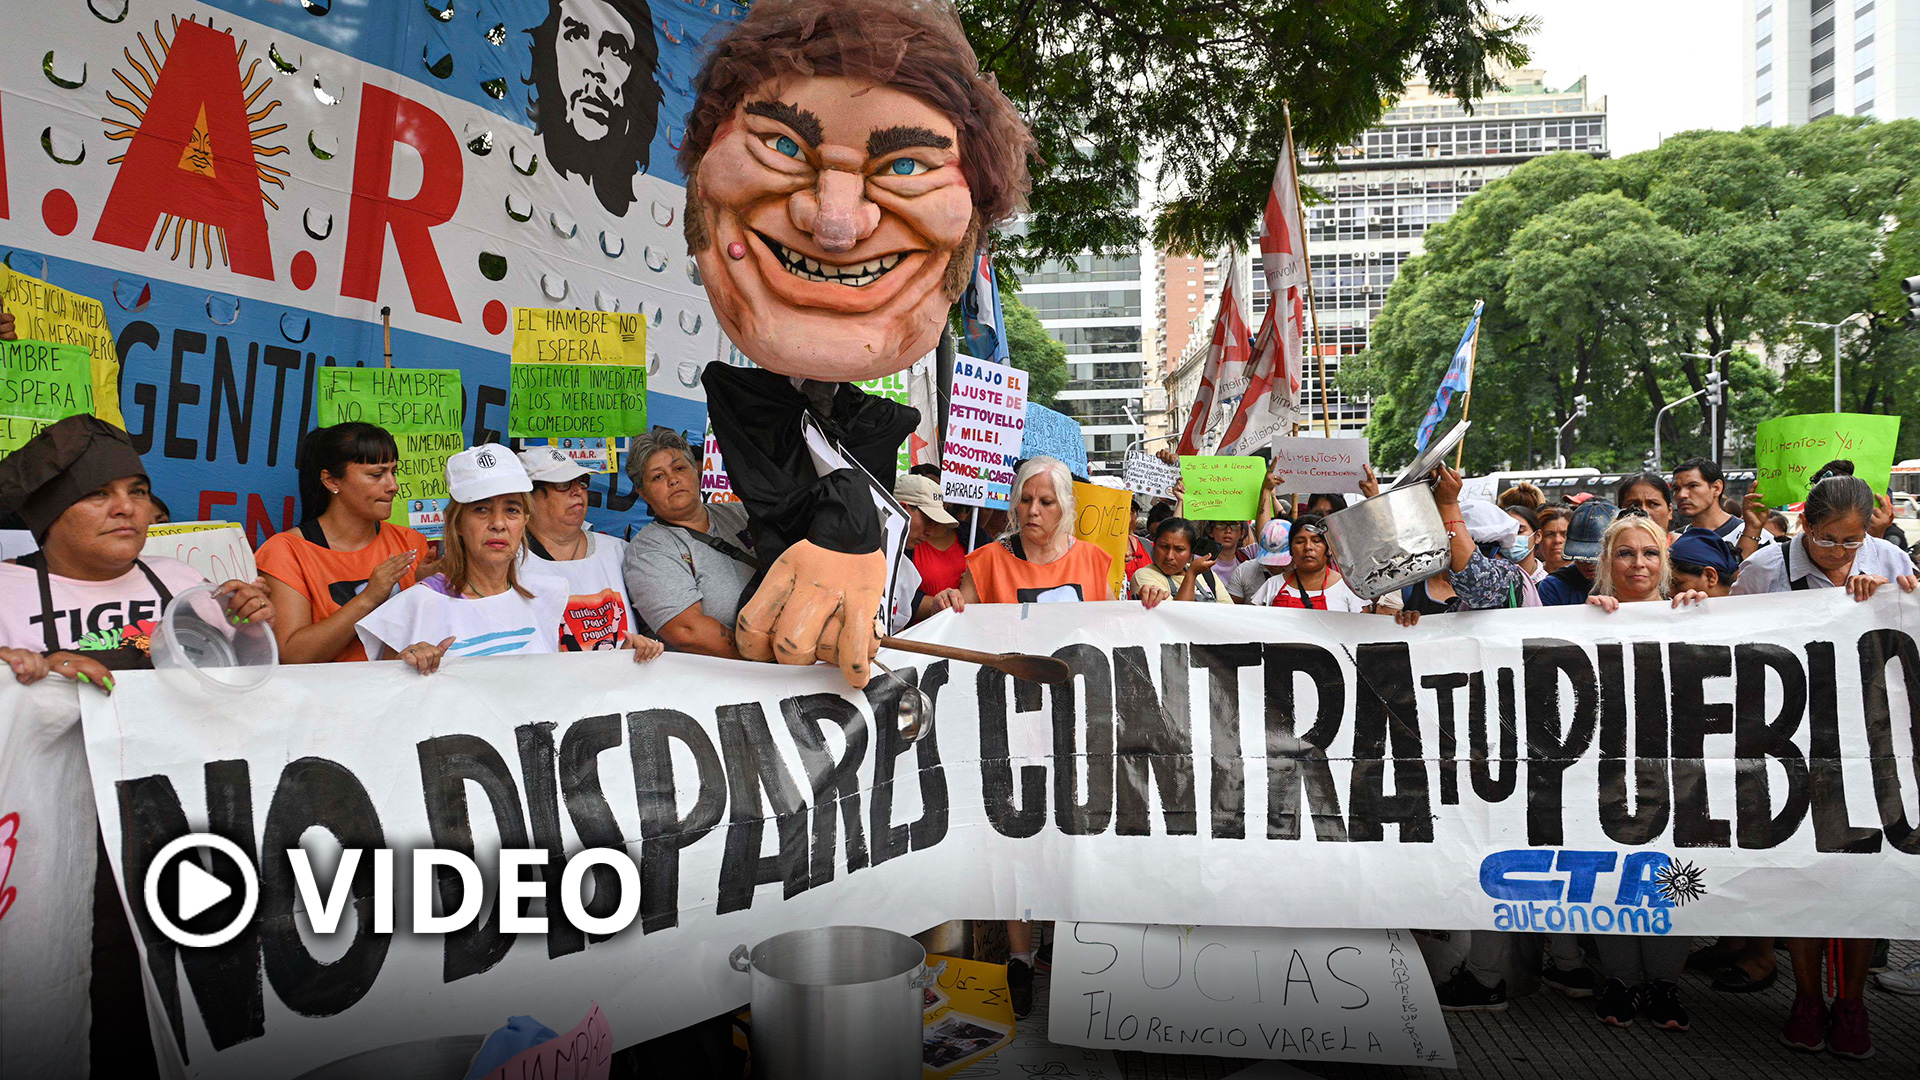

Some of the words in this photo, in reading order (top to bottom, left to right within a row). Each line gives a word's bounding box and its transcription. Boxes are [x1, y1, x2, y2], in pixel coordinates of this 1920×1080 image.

[518, 309, 537, 331] EL
[547, 310, 608, 334] HAMBRE
[619, 315, 637, 335] NO
[373, 371, 449, 398] HAMBRE
[512, 365, 580, 389] ASISTENCIA
[590, 367, 645, 391] INMEDIATA
[955, 361, 1003, 386] ABAJO
[1007, 376, 1021, 390] EL
[511, 393, 519, 411] A
[529, 392, 551, 411] LOS
[562, 391, 643, 411] MERENDEROS
[952, 382, 1003, 405] AJUSTE
[1006, 395, 1022, 410] DE
[338, 401, 362, 424] NO
[511, 417, 519, 432] Y
[528, 416, 605, 433] COMEDORES
[950, 403, 1024, 430] PETTOVELLO
[407, 433, 461, 453] INMEDIATA
[949, 423, 957, 436] Y
[961, 427, 1002, 446] MILEI.
[944, 442, 1002, 465] NOSOTRXS
[945, 482, 983, 500] BARRACAS
[416, 659, 949, 983] DISPARES
[976, 642, 1433, 843] CONTRA
[1421, 666, 1514, 805] TU
[1522, 628, 1920, 853] PUEBLO
[1479, 849, 1676, 909] CTA
[1493, 900, 1673, 935] autónoma
[1074, 922, 1369, 1010] SUCIAS
[1084, 990, 1247, 1046] FLORENCIO
[1258, 1024, 1383, 1054] VARELA
